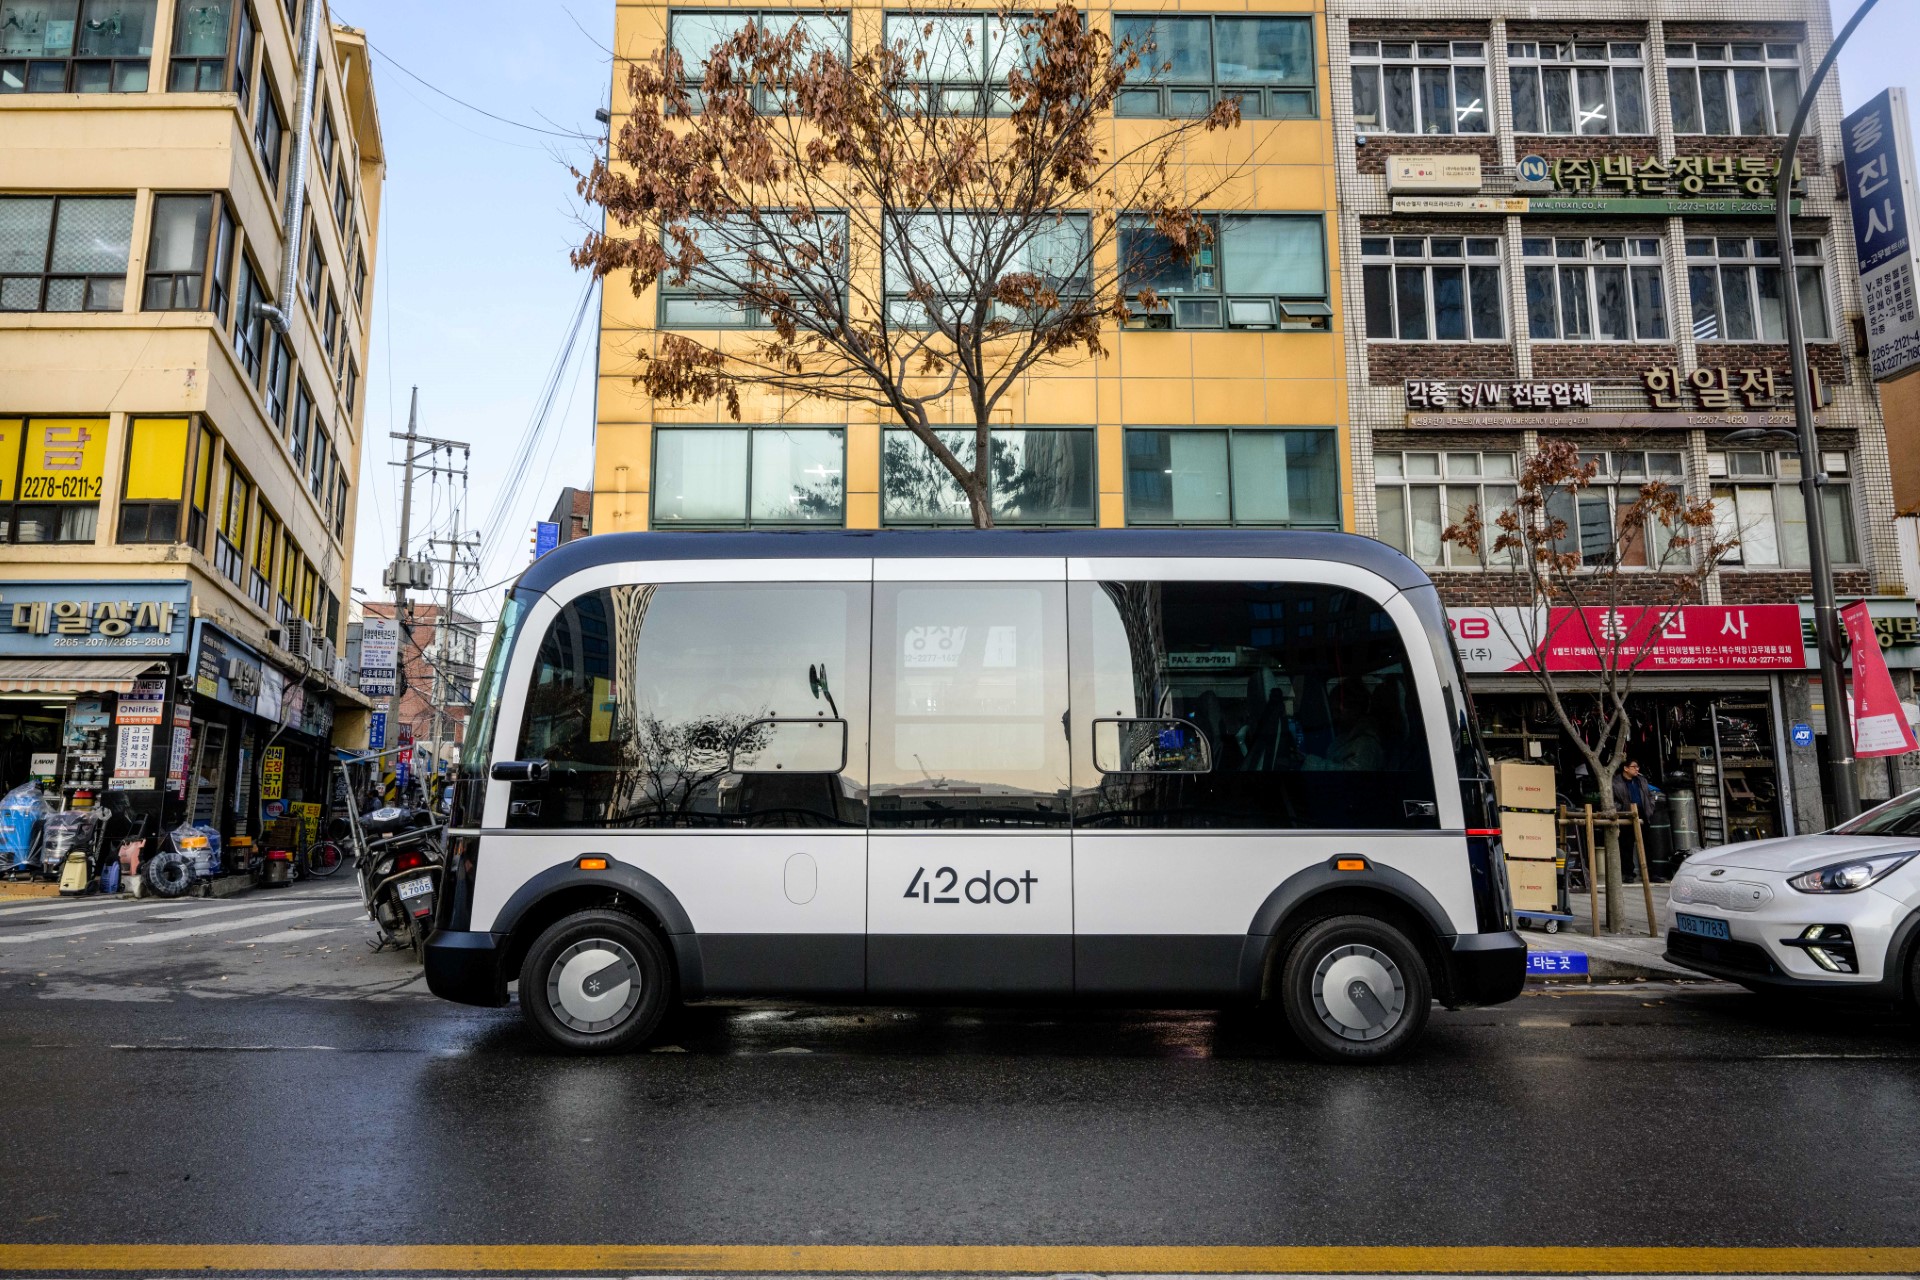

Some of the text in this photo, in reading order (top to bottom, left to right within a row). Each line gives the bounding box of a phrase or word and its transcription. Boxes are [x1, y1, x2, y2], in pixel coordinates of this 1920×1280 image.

[1852, 110, 1895, 243] 흥진사
[1529, 201, 1608, 210] www.nexn.co.kr
[1667, 201, 1726, 212] T.2273-1212
[1409, 382, 1593, 406] 각종 S/W 전문업체
[1687, 416, 1749, 426] T.2267-4620
[23, 476, 103, 498] 2278-6211~2
[12, 601, 178, 637] 대일상사
[54, 637, 171, 647] 2265-2071/2265-2808
[1669, 656, 1712, 664] 02-2265-2121
[128, 705, 159, 713] Nilfisk
[1795, 730, 1810, 740] ADT
[264, 761, 282, 773] 도장
[263, 773, 281, 786] 문구
[409, 883, 431, 895] 7005
[903, 866, 1038, 904] 42dot
[1701, 920, 1724, 937] 7783
[1533, 956, 1557, 970] 타는
[1559, 956, 1571, 970] 곳
